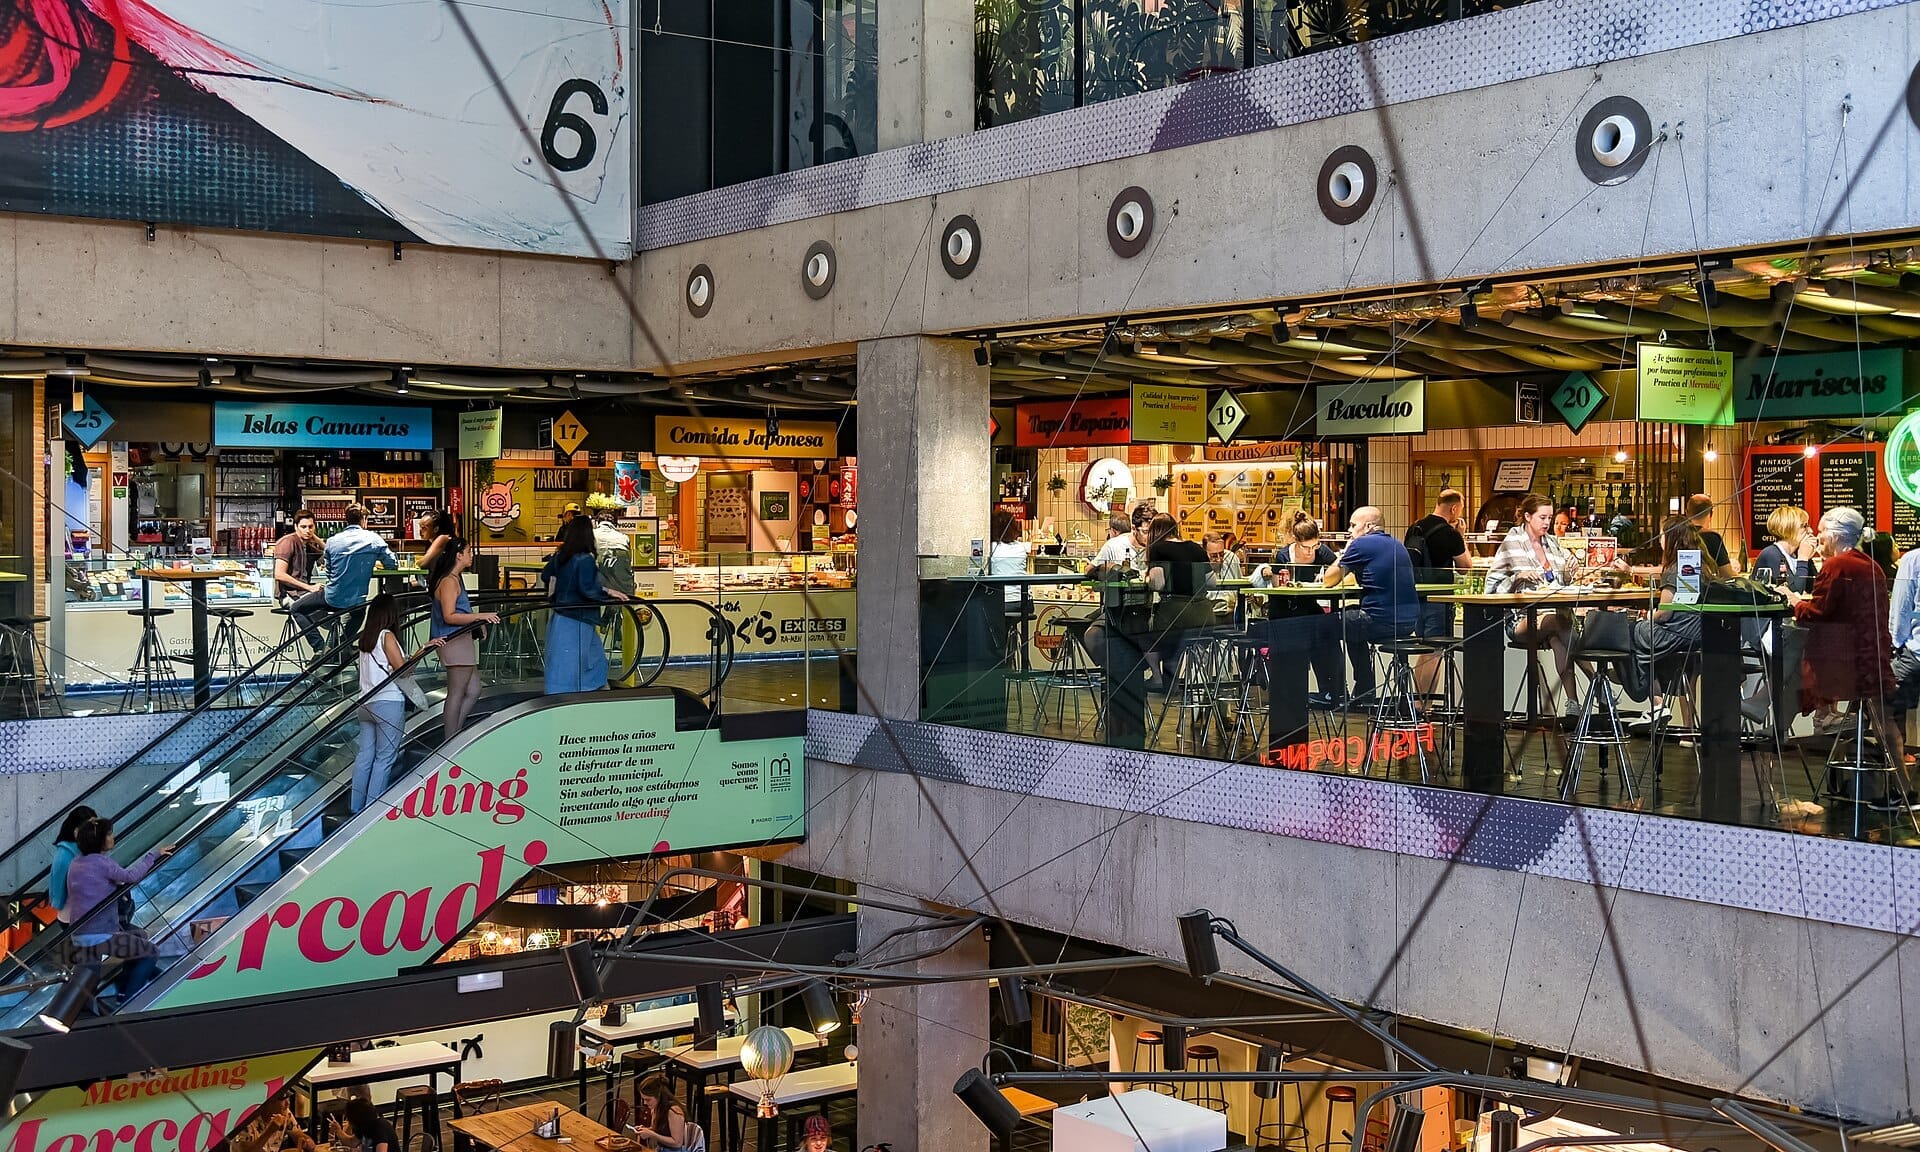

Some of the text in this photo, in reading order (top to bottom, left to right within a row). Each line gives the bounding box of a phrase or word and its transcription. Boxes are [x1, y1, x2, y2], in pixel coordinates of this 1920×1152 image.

[540, 78, 609, 172] 6
[1660, 366, 1682, 375] buenos
[1654, 378, 1680, 388] Practica
[1682, 380, 1687, 388] el
[1746, 368, 1887, 401] Mariscos
[1563, 386, 1591, 408] 20
[1216, 406, 1236, 426] 19
[1325, 394, 1413, 421] Bacalao
[75, 410, 102, 429] 25
[241, 414, 409, 437] Islas Canarias
[1070, 411, 1131, 437] Españo
[559, 424, 579, 440] 17
[670, 426, 824, 451] Comida Japonesa
[618, 475, 641, 502] 氷
[559, 730, 656, 745] Hace muchos años
[559, 743, 675, 759] cambiamos la manera
[559, 757, 653, 773] de disfrutar de un
[731, 761, 758, 770] Somos
[737, 769, 758, 777] como
[559, 768, 663, 786] mercado municipal.
[719, 776, 759, 788] queremos
[559, 779, 699, 800] Sin saberlo, nos estábamos
[559, 793, 698, 813] inventando algo que ahora
[559, 808, 670, 827] llamamos Mercading
[188, 840, 548, 979] rcad
[81, 1061, 248, 1107] Mercading
